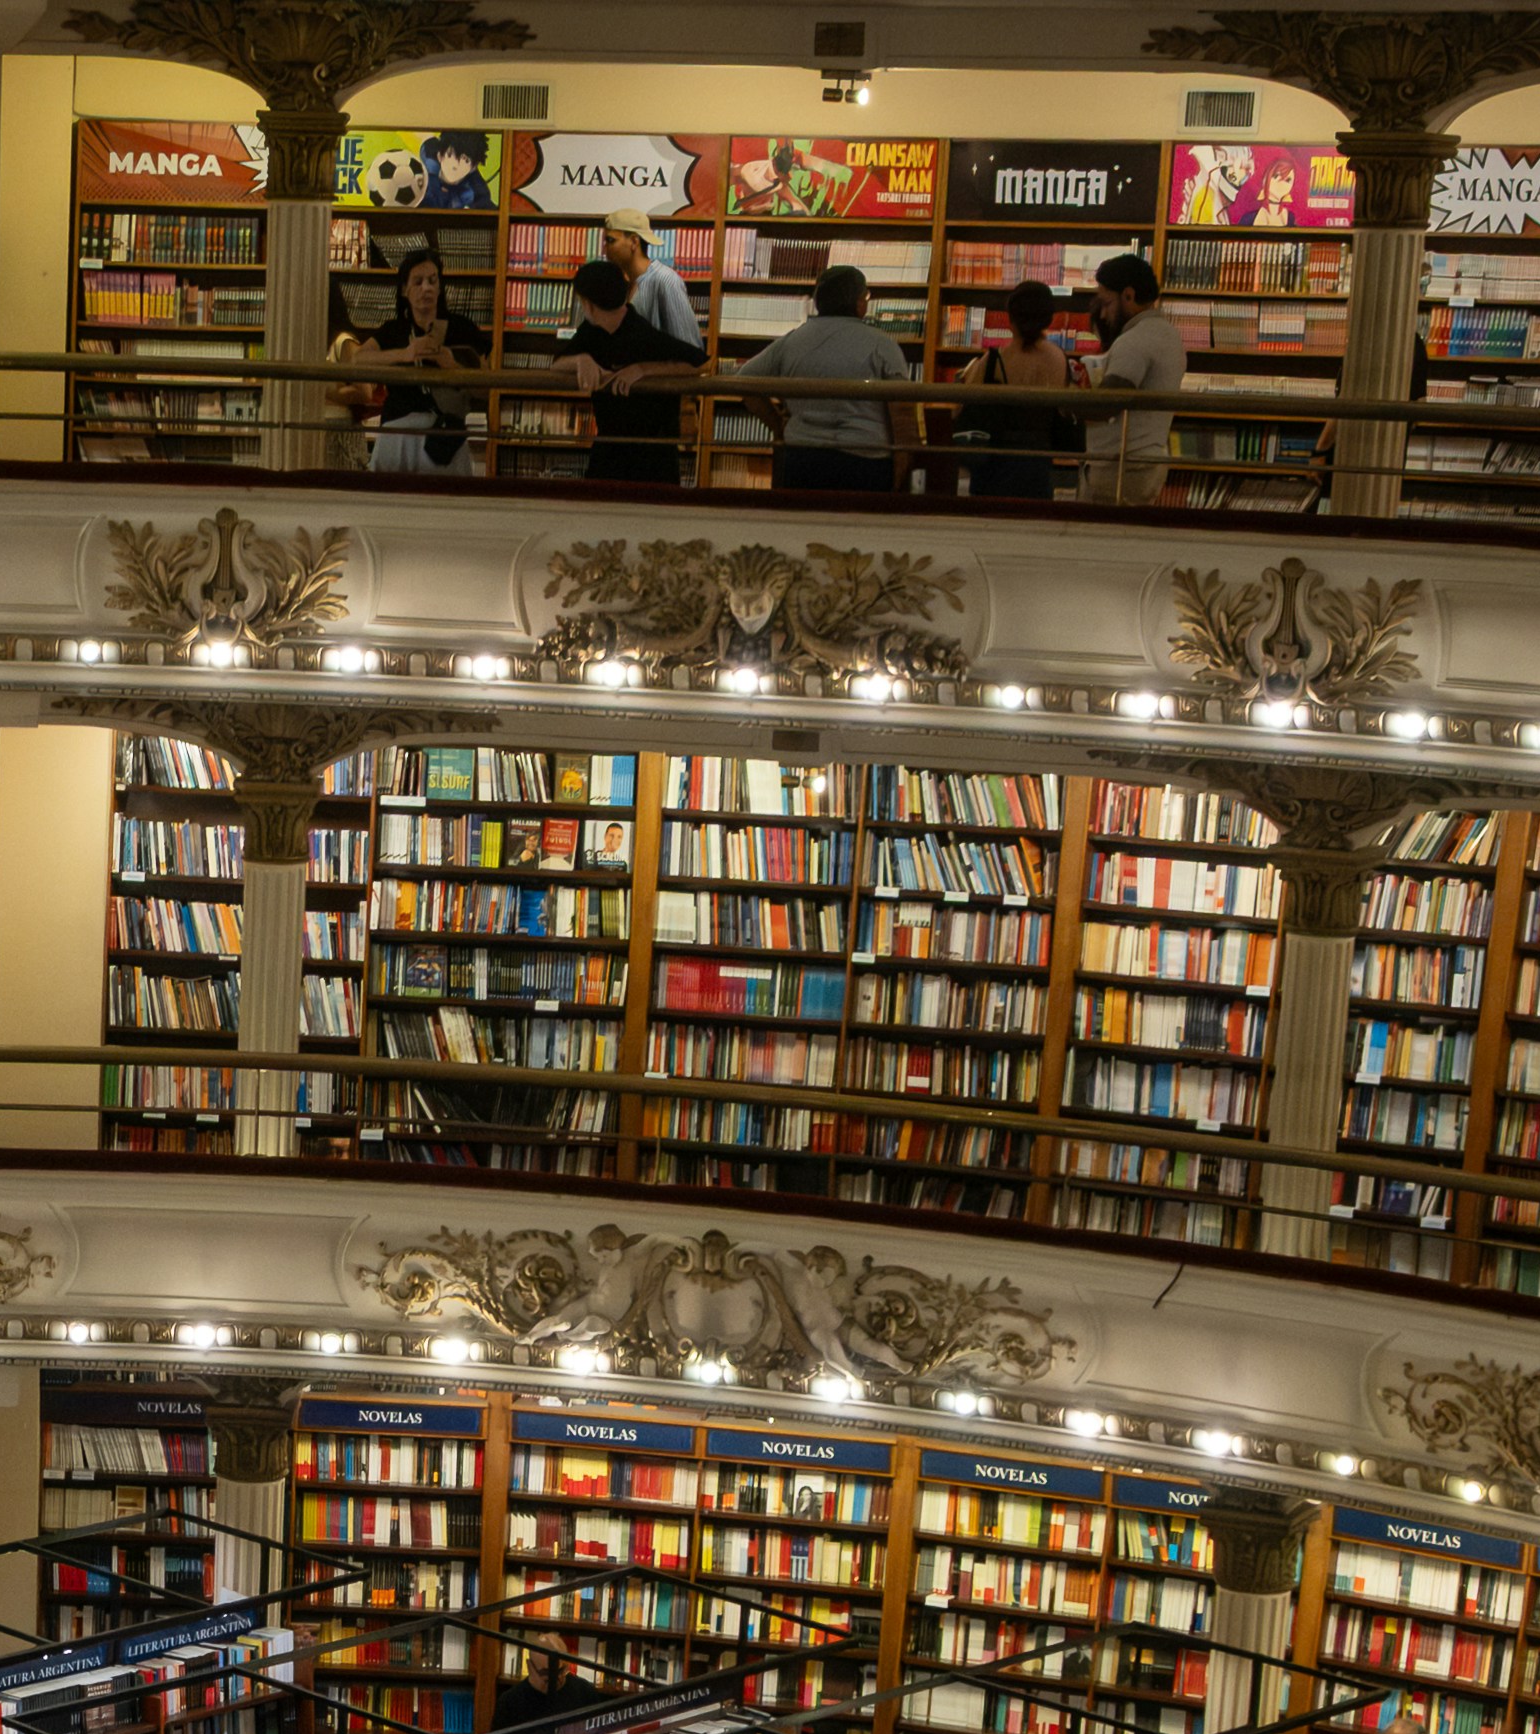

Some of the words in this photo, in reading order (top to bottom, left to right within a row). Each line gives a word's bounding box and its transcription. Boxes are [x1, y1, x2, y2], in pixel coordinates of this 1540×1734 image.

[108, 151, 223, 178] MANGA
[335, 138, 364, 166] UE
[846, 143, 934, 168] CHAINSAW
[334, 167, 363, 194] CK
[560, 163, 668, 189] MANGA
[888, 168, 933, 193] MAN
[994, 168, 1108, 208] MANGA
[137, 1401, 202, 1414] NOVELAS
[358, 1409, 422, 1424] NOVELAS
[565, 1423, 637, 1441] NOVELAS
[762, 1440, 835, 1459] NOVELAS
[975, 1463, 1048, 1485] NOVELAS
[1387, 1524, 1461, 1549] NOVELAS
[128, 1632, 192, 1657] LITERATURA
[193, 1617, 253, 1642] ARGENTINA
[37, 1656, 101, 1680] ARGENTINA
[585, 1701, 647, 1731] LITERATURA
